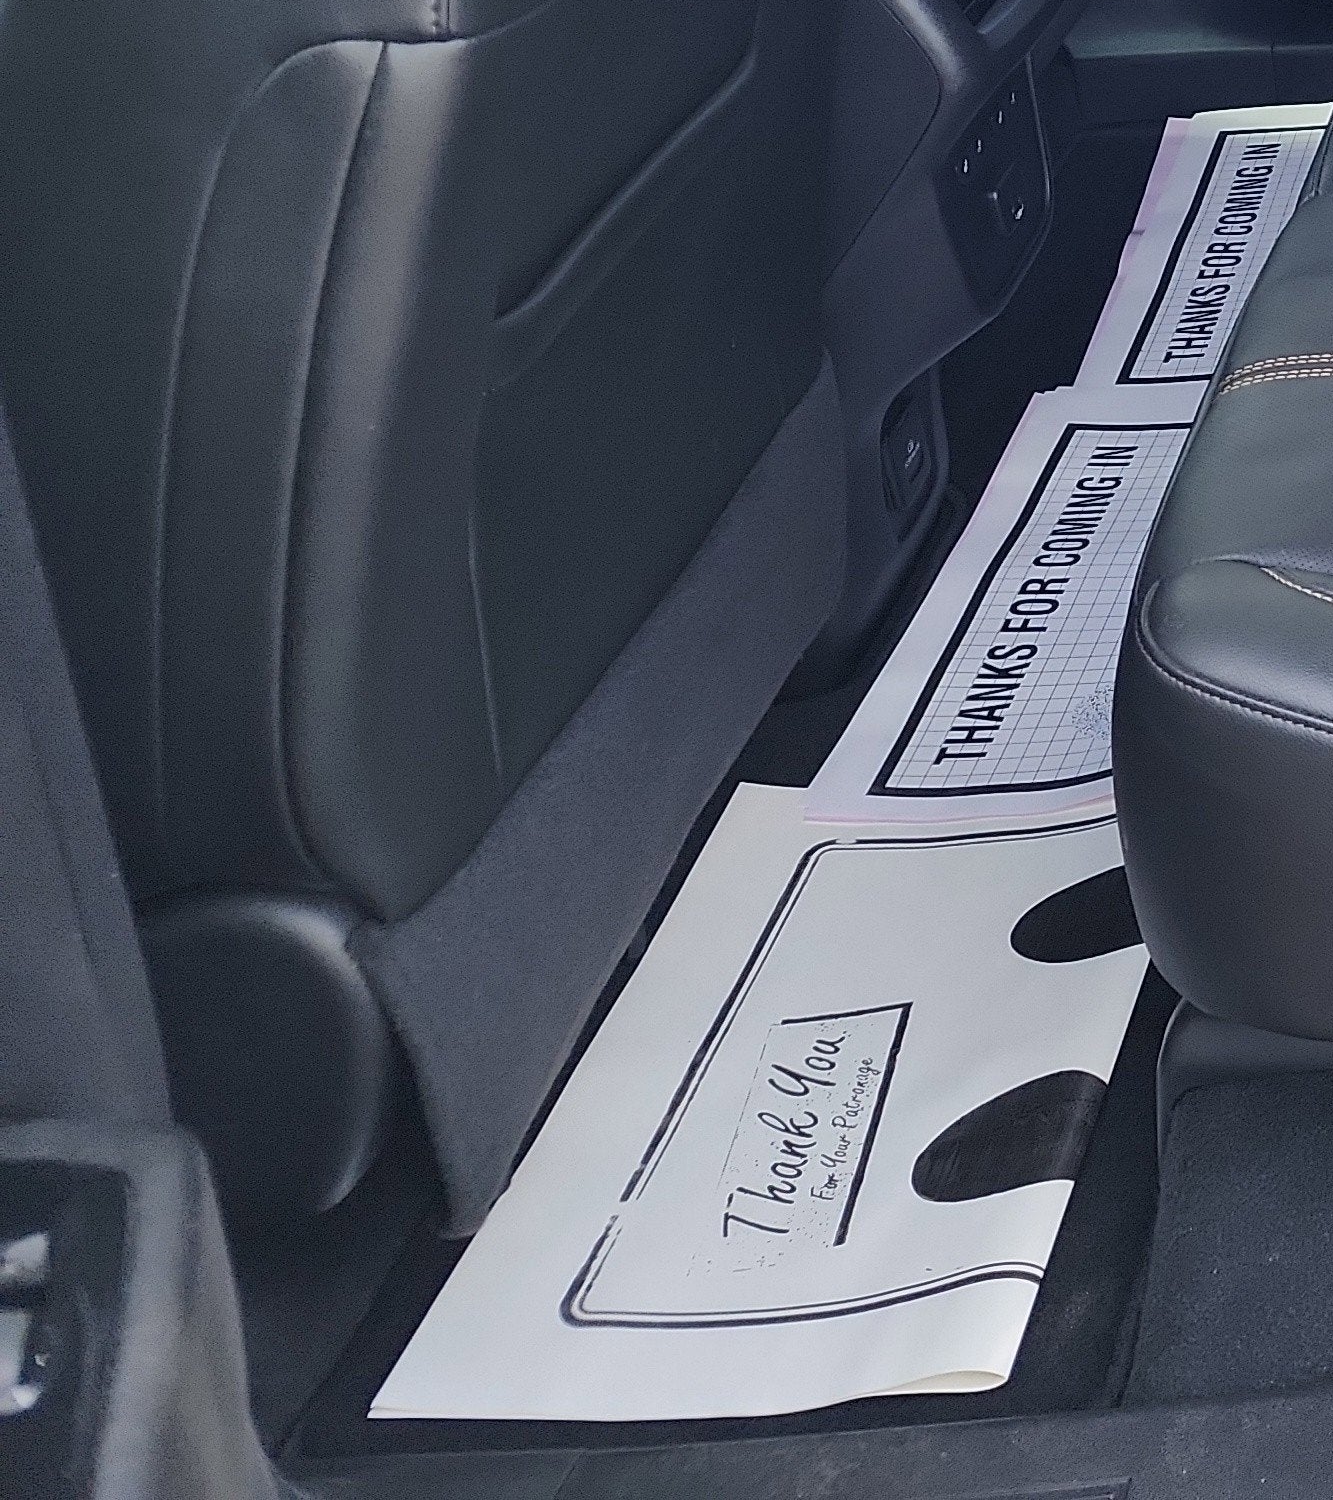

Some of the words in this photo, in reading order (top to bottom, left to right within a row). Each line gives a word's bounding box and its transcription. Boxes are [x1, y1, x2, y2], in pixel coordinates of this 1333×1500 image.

[1241, 142, 1282, 161] IN
[1213, 164, 1274, 235] COMING
[1197, 241, 1248, 280] FOR
[1163, 284, 1231, 363] THANKS
[1087, 445, 1139, 467] IN
[1032, 476, 1123, 567] COMING
[1001, 577, 1070, 633] FOR
[933, 644, 1039, 766] THANKS
[831, 1057, 881, 1130] Patronage
[722, 1110, 819, 1238] Thank
[820, 1133, 851, 1169] Your
[810, 1172, 840, 1201] For
